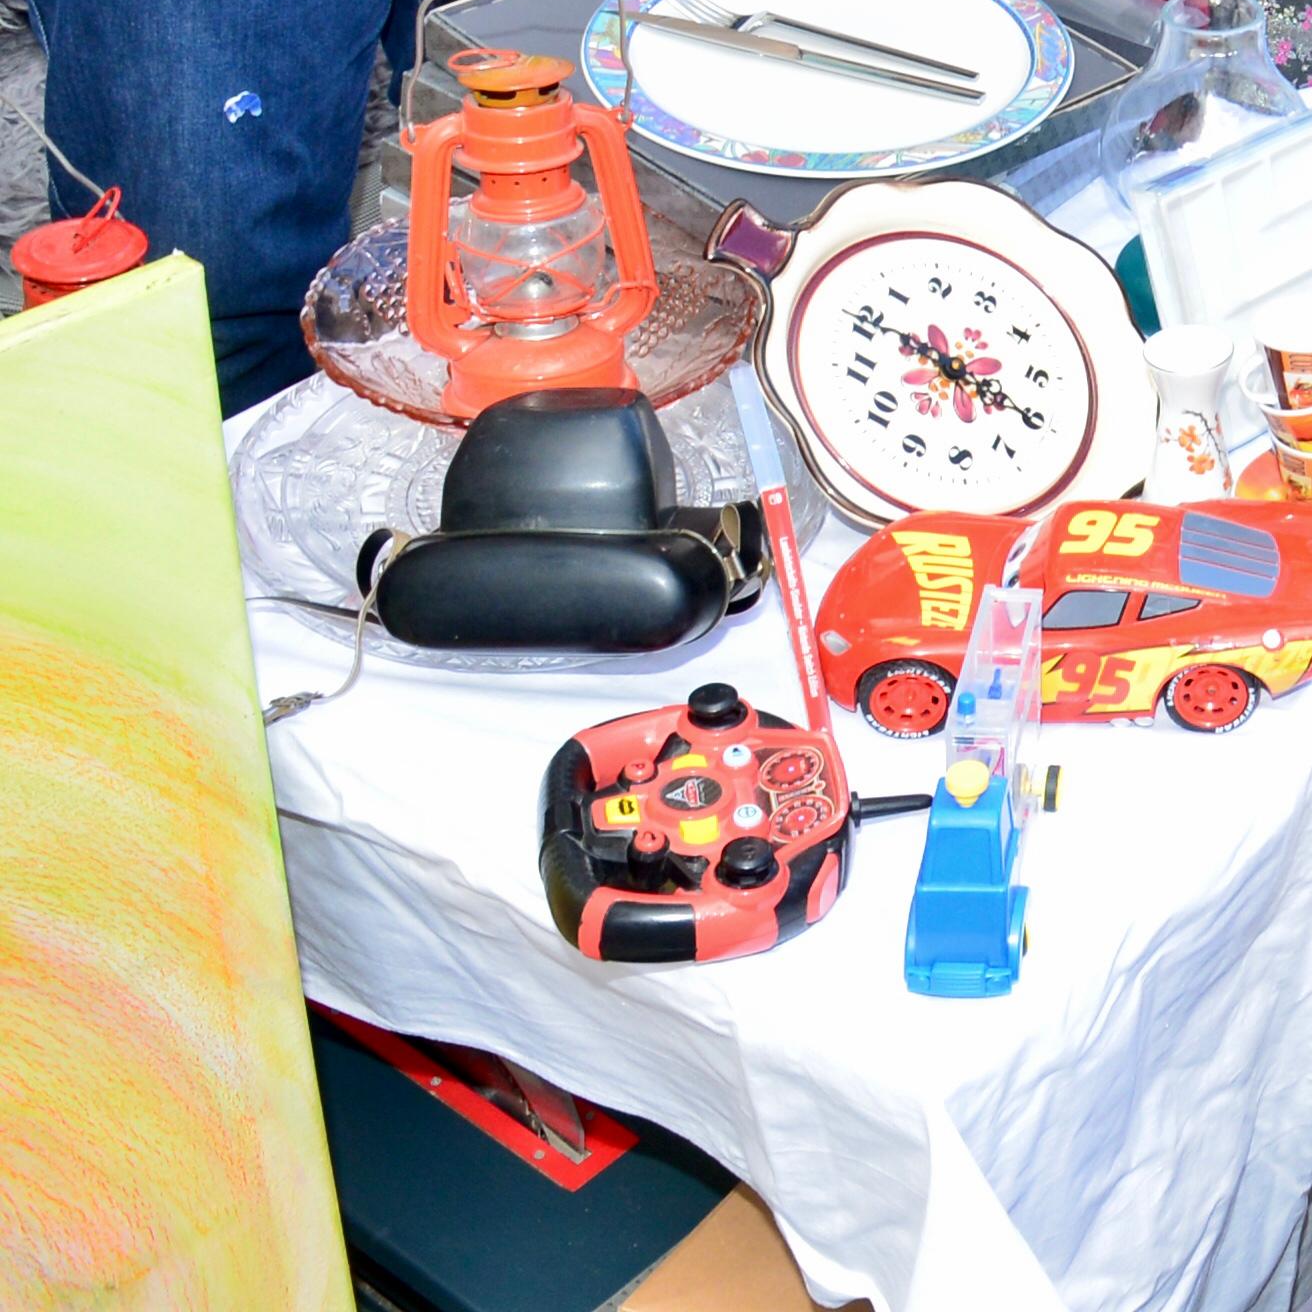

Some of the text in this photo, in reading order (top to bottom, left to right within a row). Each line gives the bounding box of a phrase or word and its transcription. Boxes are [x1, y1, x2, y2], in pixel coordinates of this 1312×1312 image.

[974, 290, 997, 314] 3
[846, 352, 877, 386] 11
[1024, 364, 1050, 389] 5
[867, 391, 899, 429] 10
[1021, 406, 1046, 431] 6
[902, 433, 927, 458] 9
[948, 445, 974, 471] 8
[991, 434, 1016, 460] 7
[1059, 509, 1161, 557] 95
[1056, 649, 1136, 705] 95
